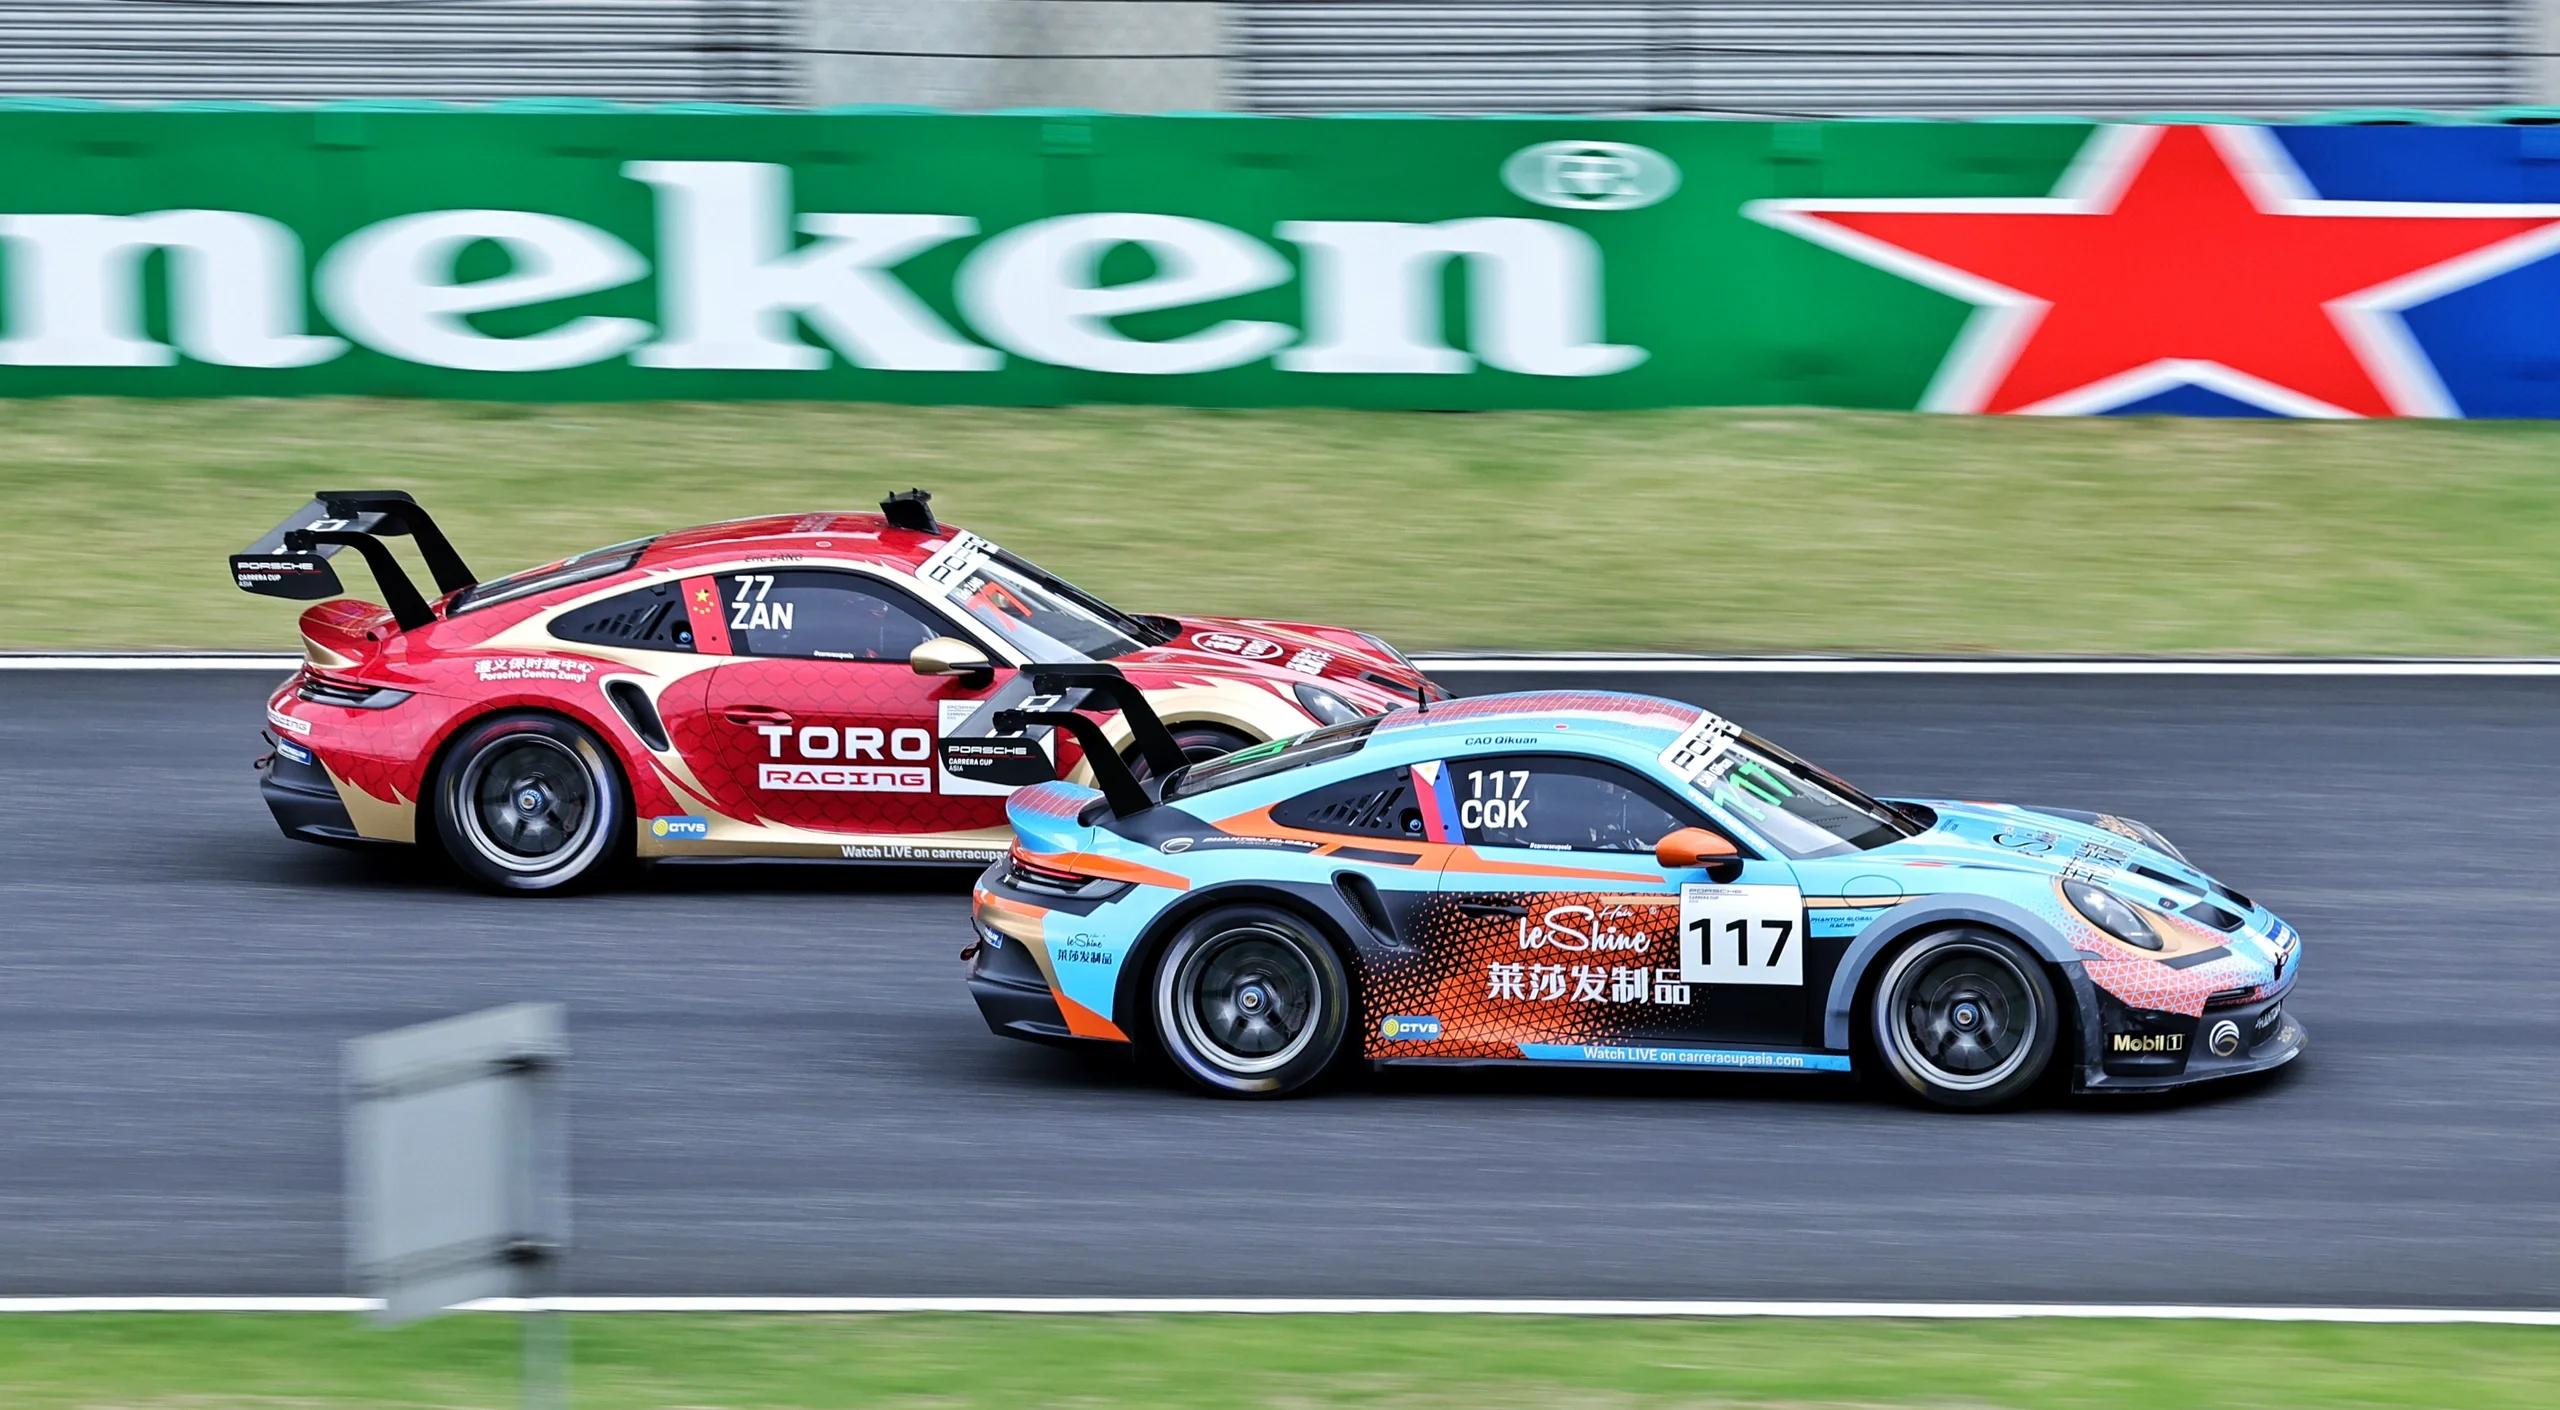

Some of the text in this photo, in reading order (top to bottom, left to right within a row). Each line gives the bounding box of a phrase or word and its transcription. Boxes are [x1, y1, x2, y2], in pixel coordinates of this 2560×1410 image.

[237, 562, 314, 570] PORSCHE
[734, 575, 774, 602] 77
[730, 602, 794, 630] ZAN
[480, 671, 587, 683] Porsche Centre Zunyi
[758, 726, 931, 761] TORO
[948, 746, 1027, 755] PORSCHE
[1465, 736, 1537, 745] CAO Qikuan
[948, 758, 978, 766] CARRERA
[766, 770, 925, 787] RACING
[1467, 770, 1530, 799] 117
[1713, 761, 1794, 822] 117
[1461, 800, 1529, 829] CQK
[842, 845, 881, 858] Watch
[884, 846, 912, 858] LIVE
[914, 849, 929, 858] on
[1689, 918, 1793, 967] 117
[1487, 961, 1691, 1005] 莱莎发制品
[2114, 1034, 2165, 1051] Mobil
[1584, 1047, 1804, 1067] Watch LIVE on carreracupasia.com
